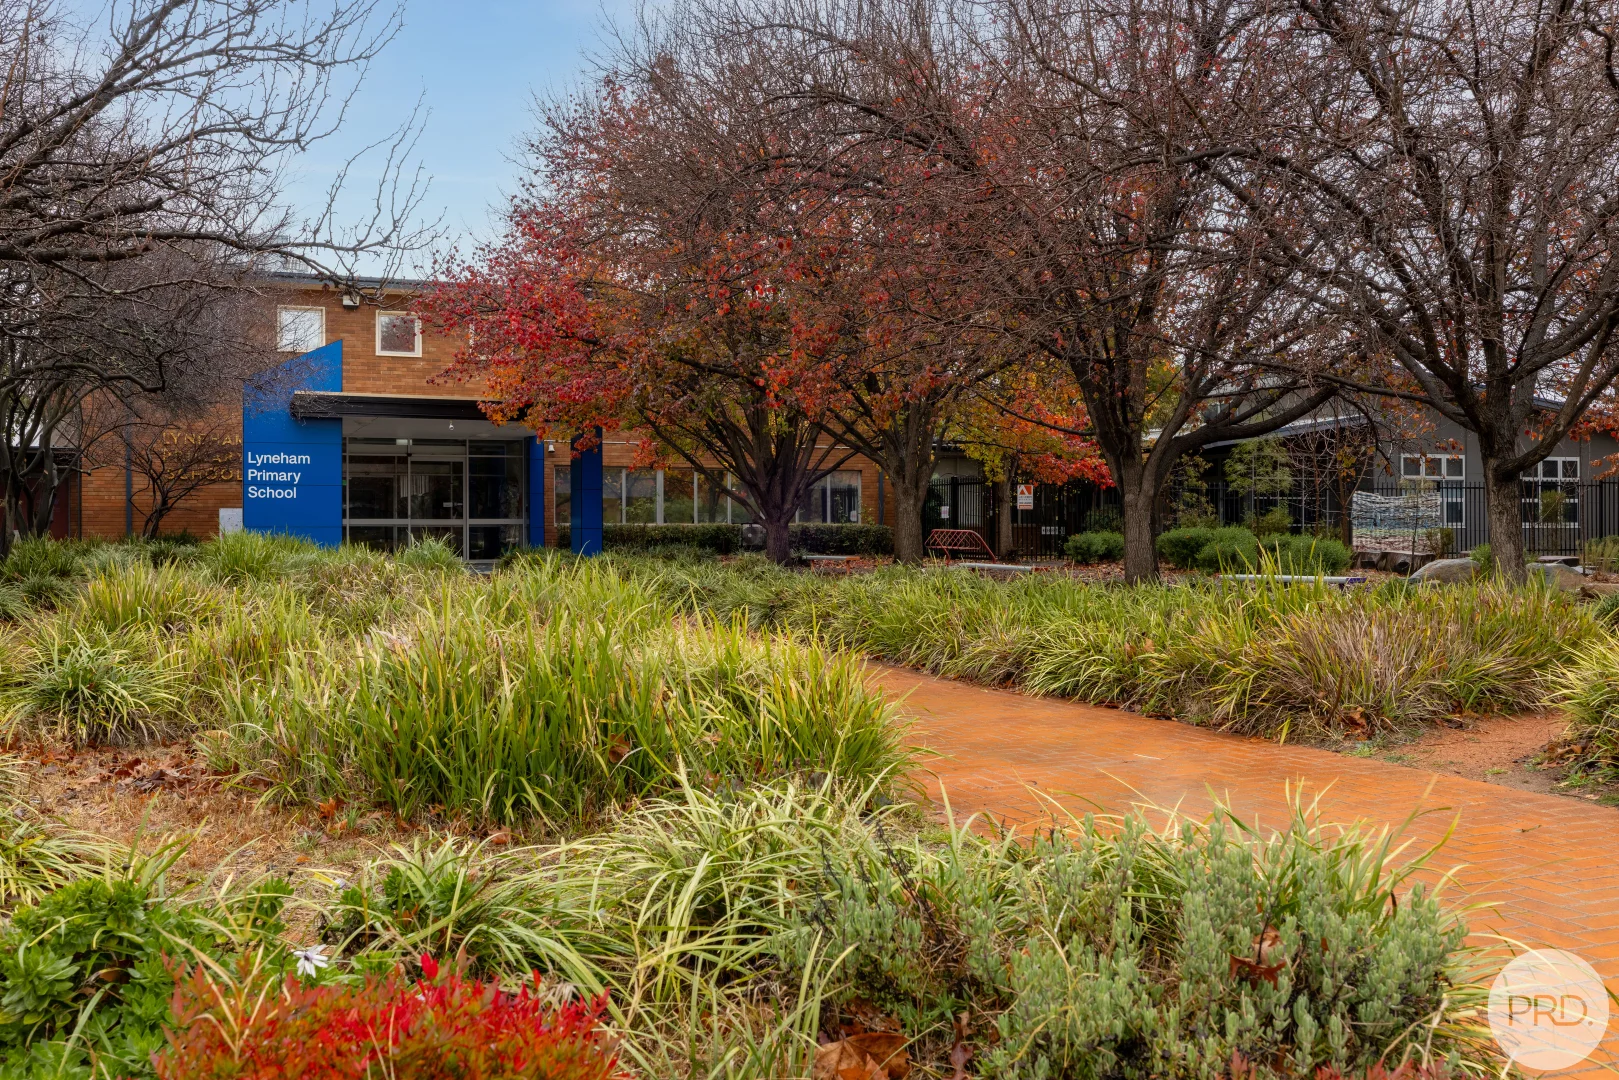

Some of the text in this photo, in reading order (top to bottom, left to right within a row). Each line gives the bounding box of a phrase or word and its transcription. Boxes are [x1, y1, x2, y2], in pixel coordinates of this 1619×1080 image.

[248, 451, 311, 467] Lyneham
[248, 469, 301, 484] Primary
[248, 486, 297, 499] School
